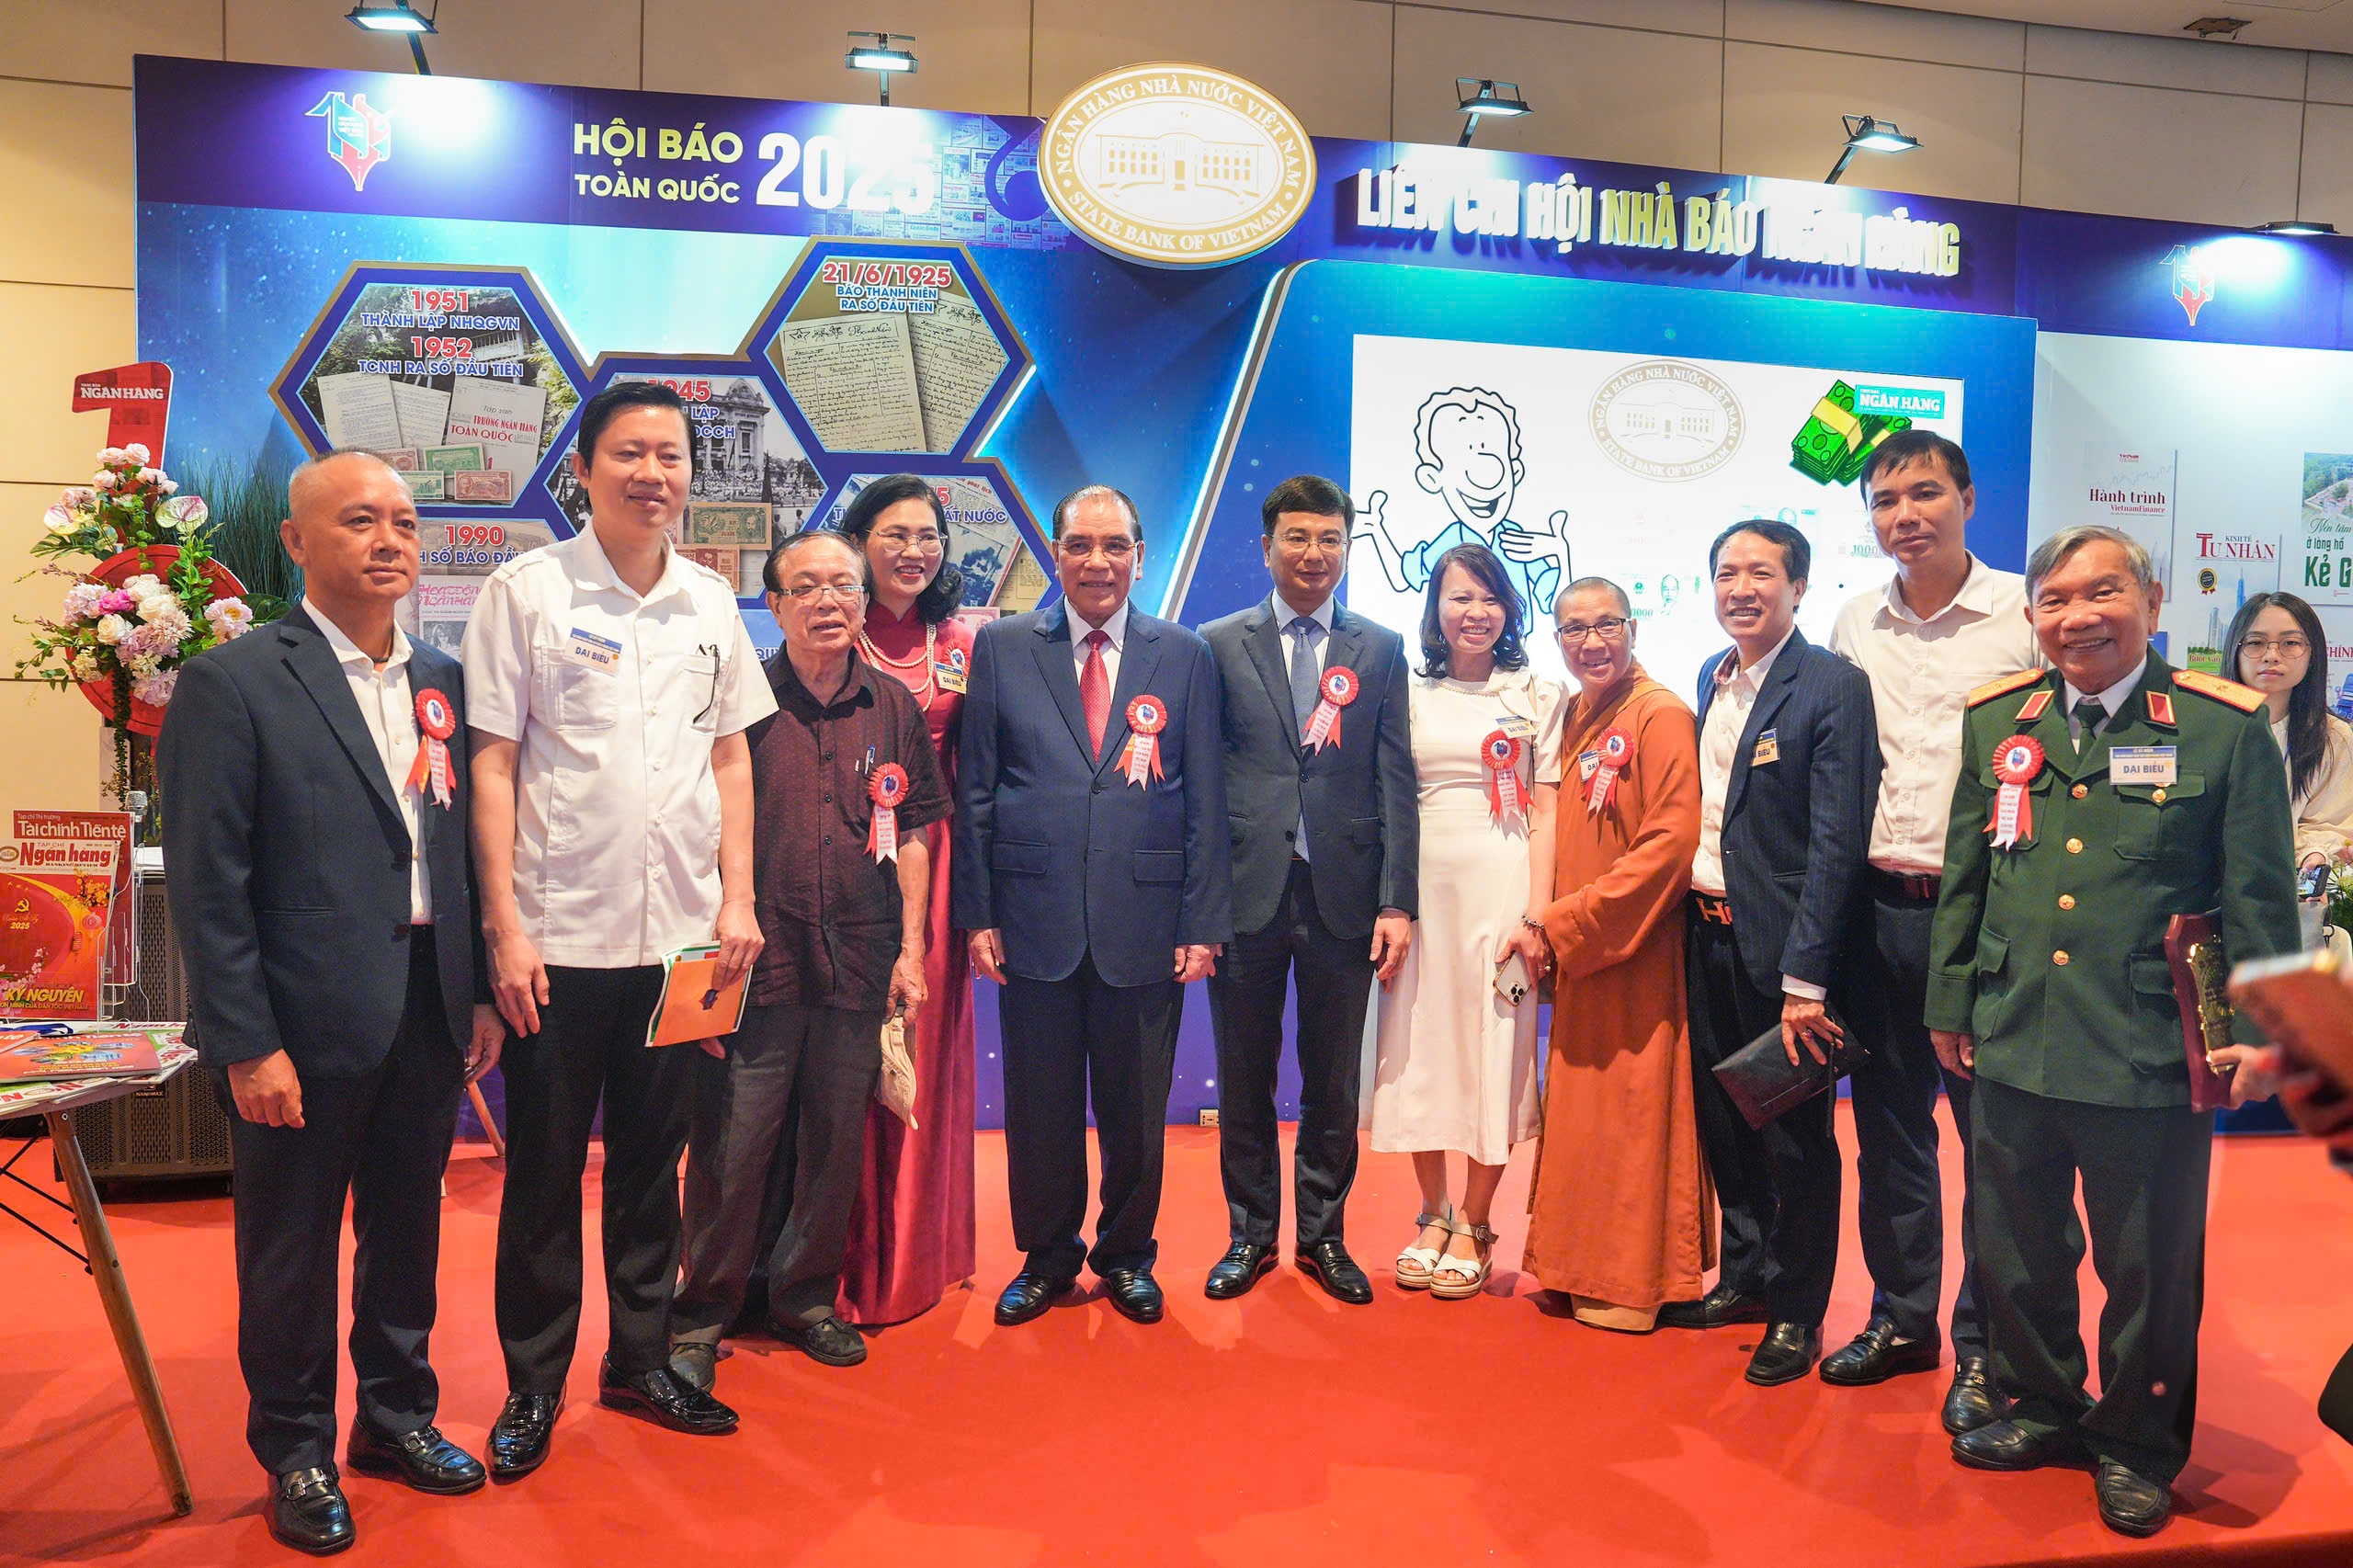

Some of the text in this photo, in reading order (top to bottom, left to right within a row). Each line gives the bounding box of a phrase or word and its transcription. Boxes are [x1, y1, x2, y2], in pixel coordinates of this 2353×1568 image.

[573, 117, 744, 166] HỘI BÁO
[1056, 74, 1303, 189] NGÂN HÀNG NHÀ NƯỚC VIỆT NAM
[574, 169, 741, 205] TOÀN QUỐC
[1068, 190, 1288, 251] STATE BANK OF VIETNAM
[1527, 173, 1592, 254] HỘI
[1599, 181, 1678, 250] NHÀ
[1684, 188, 1757, 256] BÁO
[823, 262, 952, 288] 21/6/1925
[410, 290, 469, 312] 1951
[835, 283, 938, 301] BÁO THANH NIÊN
[840, 296, 935, 313] RA SỐ ĐẦU TIÊN
[361, 310, 520, 332] THÀNH LẬP NHQGVN
[410, 336, 473, 358] 1952
[358, 357, 524, 378] TCNH RA SỐ ĐẦU TIÊN
[1646, 366, 1670, 379] NHÀ
[80, 386, 121, 399] NGÂN
[647, 379, 710, 402] 45
[1859, 393, 1900, 410] NGÂN
[692, 404, 720, 423] LẬP
[2089, 488, 2165, 505] Hành trình
[964, 507, 1008, 523] NƯỚC
[2110, 505, 2165, 514] VietnamFinance
[445, 524, 505, 546] 1990
[2313, 537, 2332, 551] lòng
[430, 545, 452, 563] SỐ
[456, 546, 489, 563] BÁO
[2225, 540, 2276, 559] NHÂN
[2304, 553, 2331, 587] Kẻ
[17, 821, 127, 841] Tài chính Tiền tệ
[20, 842, 111, 868] Ngân hàng
[26, 986, 85, 1003] NGUYÊN
